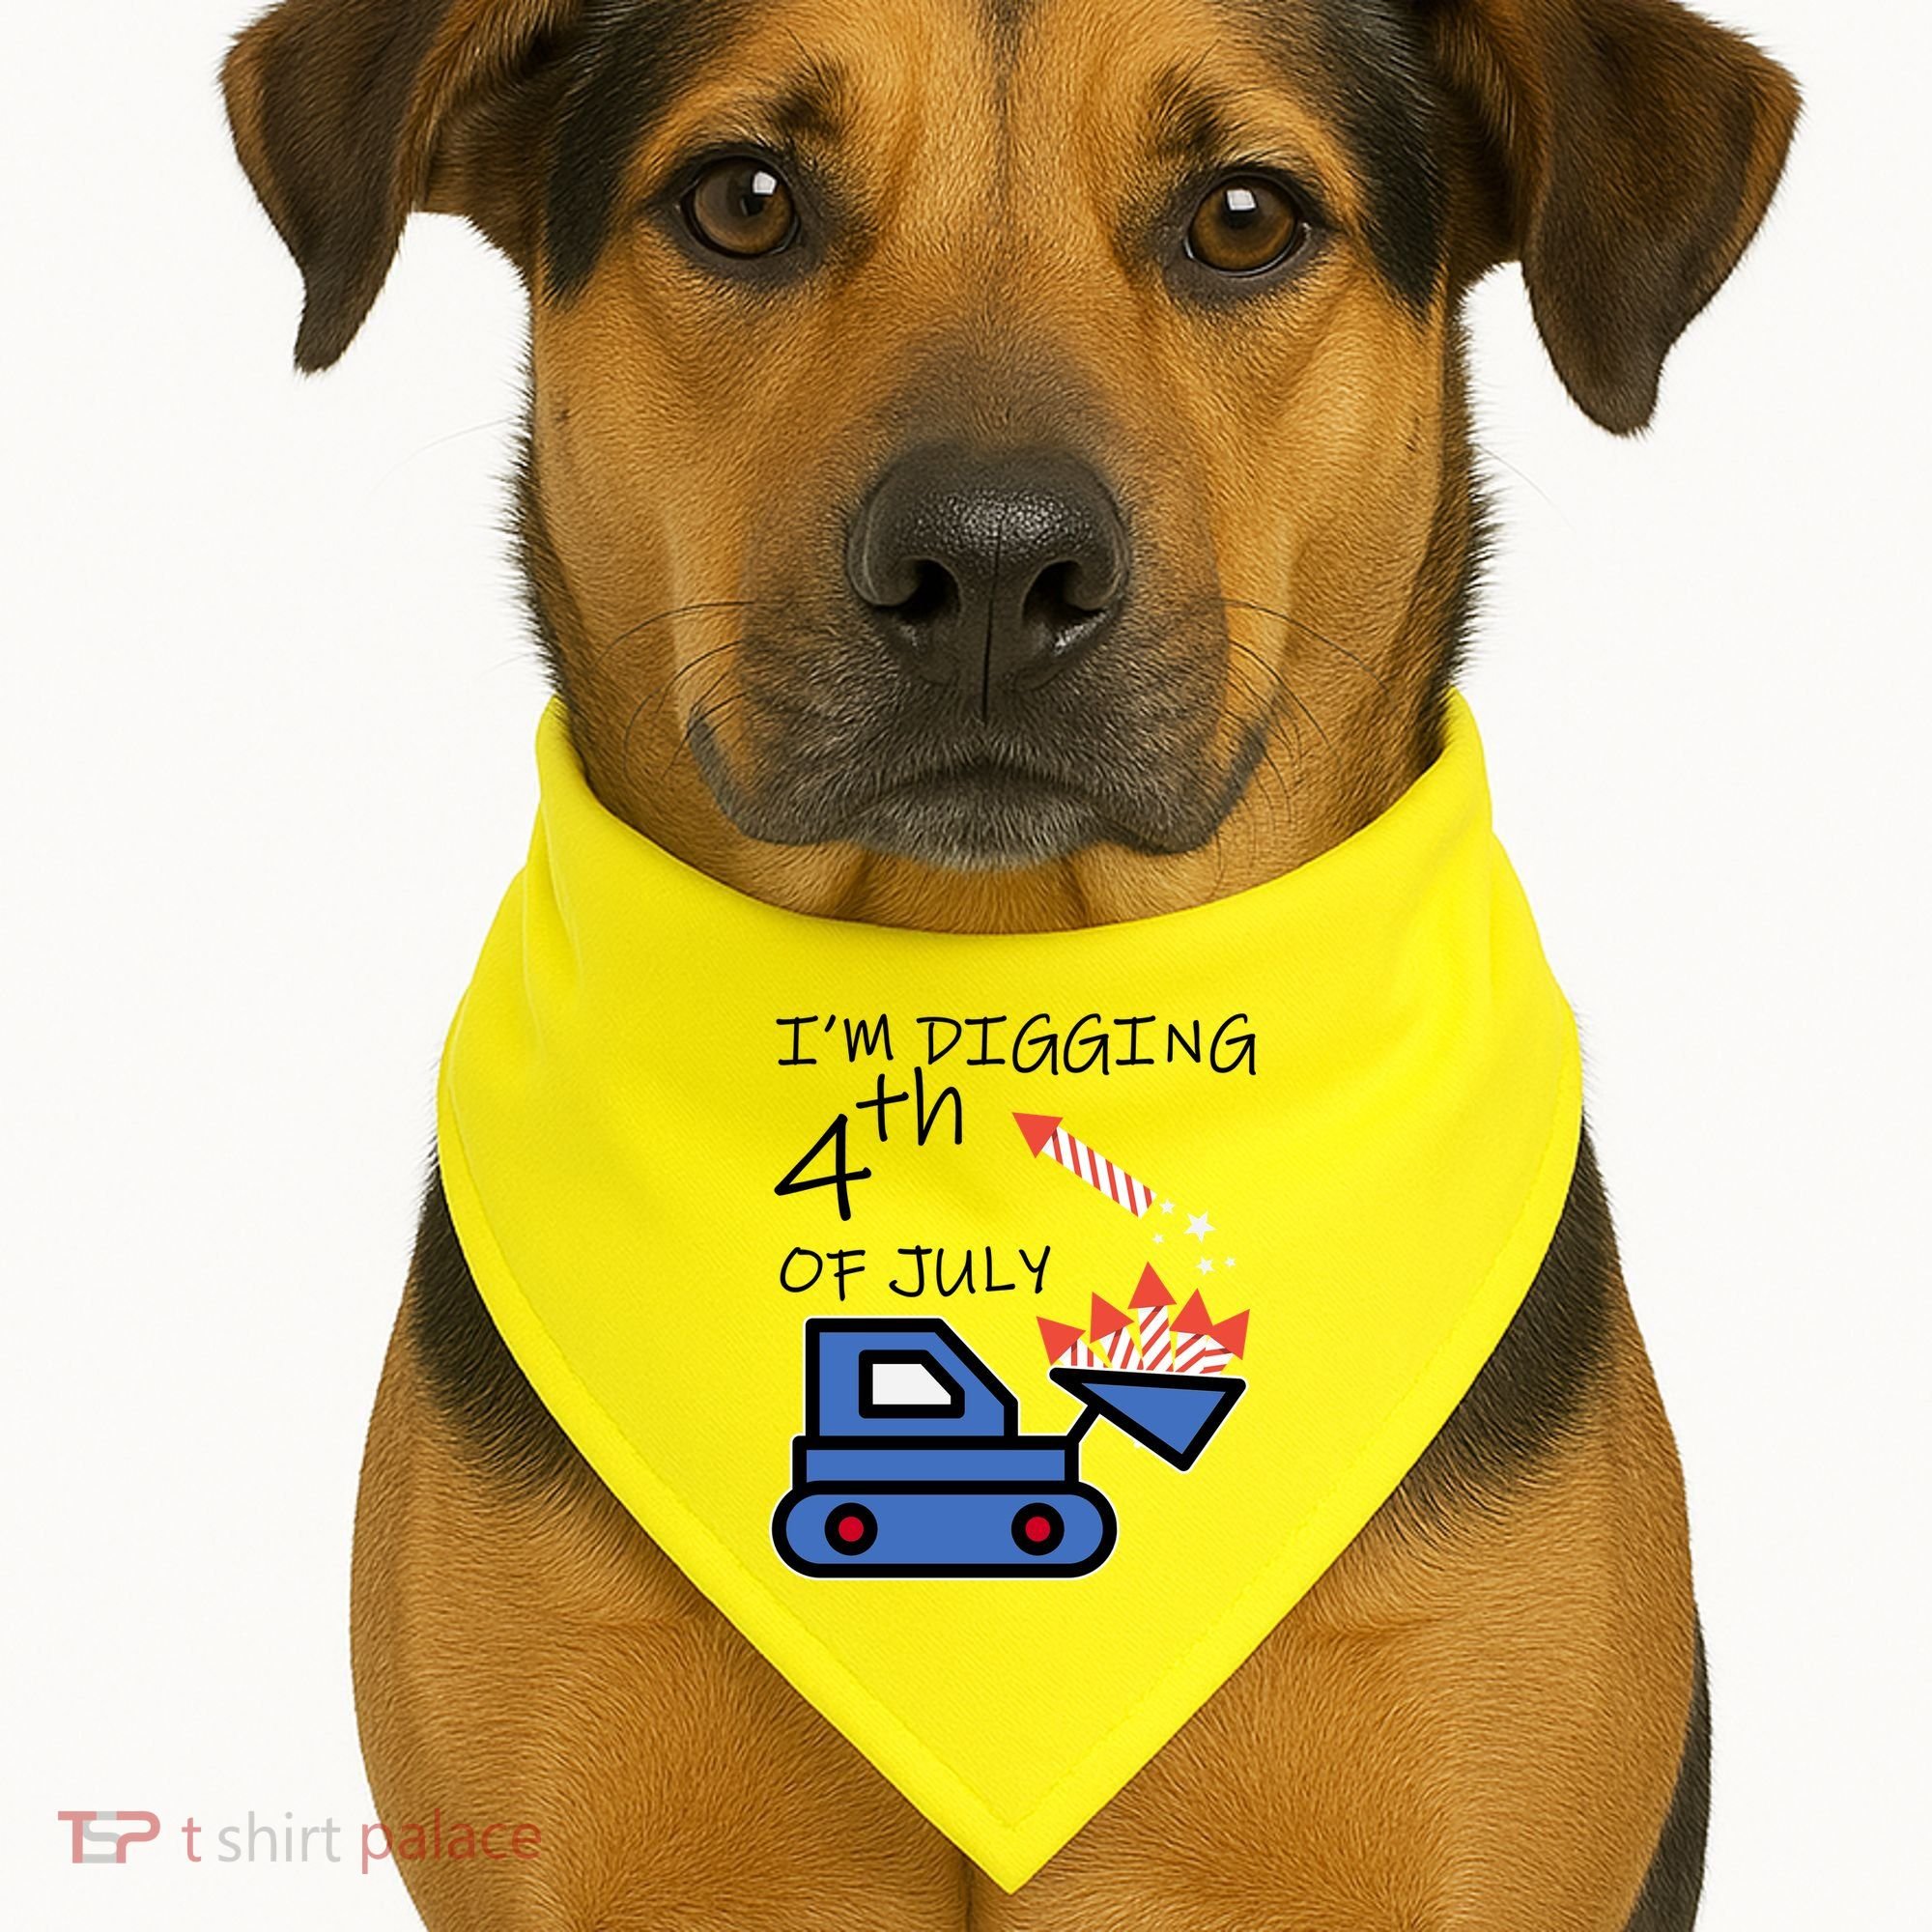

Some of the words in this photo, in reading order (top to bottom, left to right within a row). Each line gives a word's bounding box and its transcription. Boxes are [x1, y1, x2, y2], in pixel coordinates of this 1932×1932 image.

[776, 1013, 895, 1066] I'M
[916, 1012, 1257, 1076] DIGGING
[774, 1065, 963, 1222] 4th
[780, 1246, 867, 1302] OF
[889, 1244, 1051, 1298] JULY
